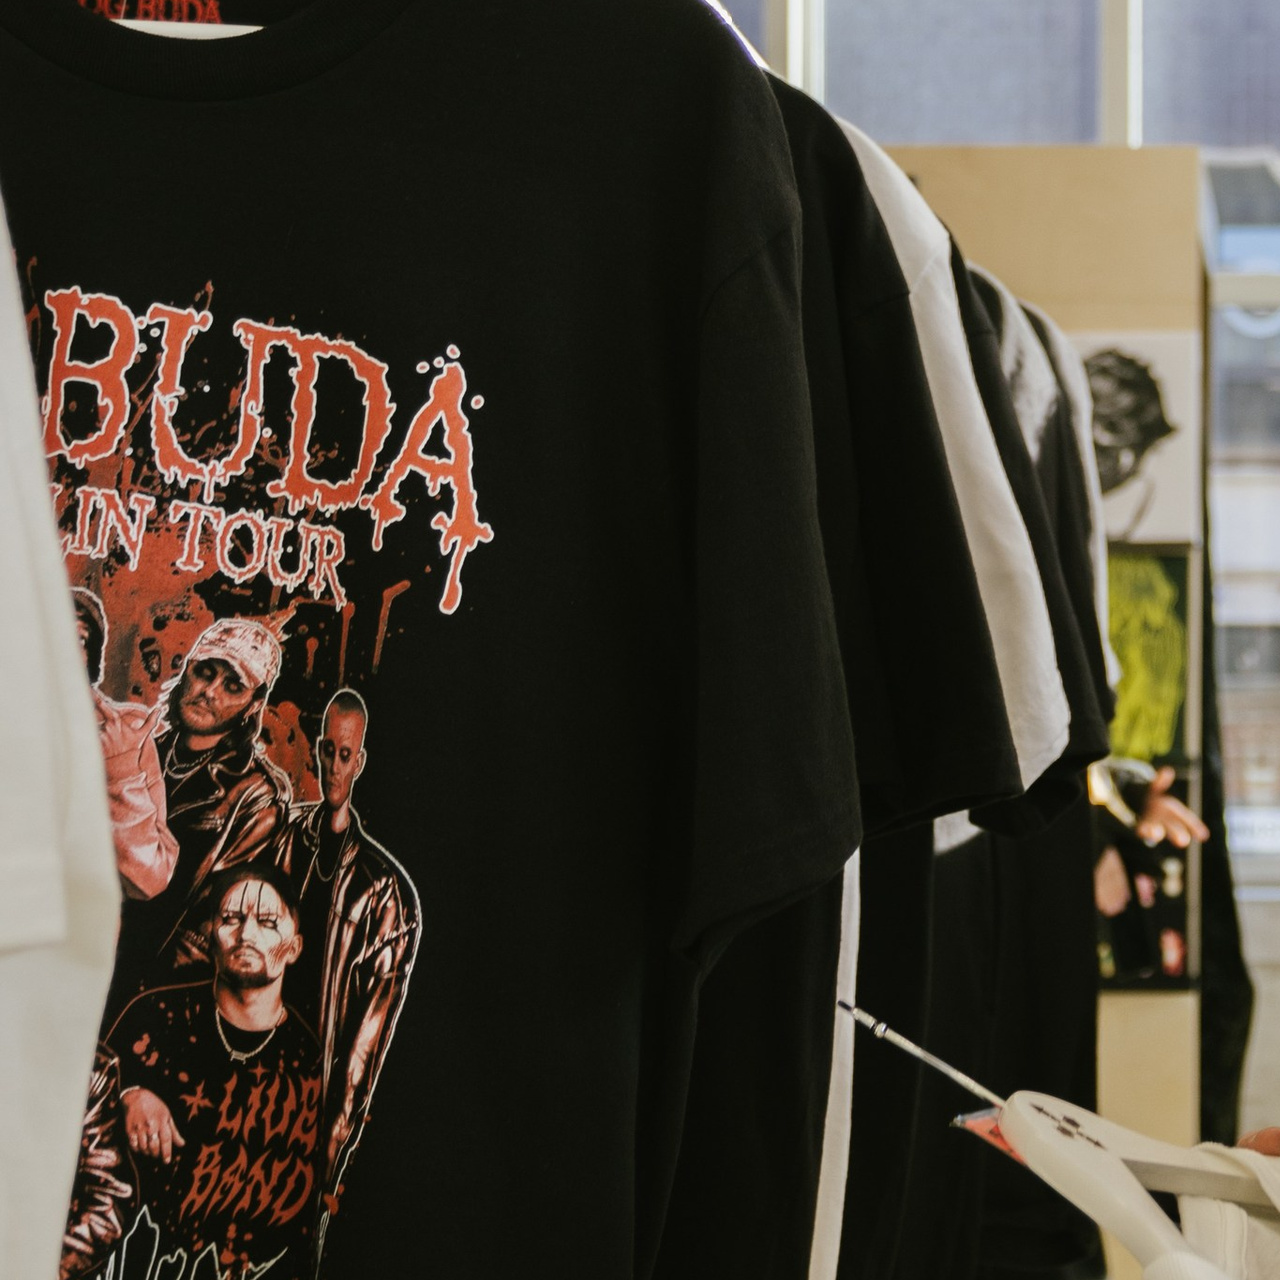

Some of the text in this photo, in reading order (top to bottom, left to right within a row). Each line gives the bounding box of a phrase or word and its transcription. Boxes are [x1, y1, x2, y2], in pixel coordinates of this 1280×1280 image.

[43, 285, 493, 614] BUDA
[169, 499, 346, 611] TOUR
[214, 1063, 323, 1154] LIVE
[179, 1141, 315, 1226] BAND
